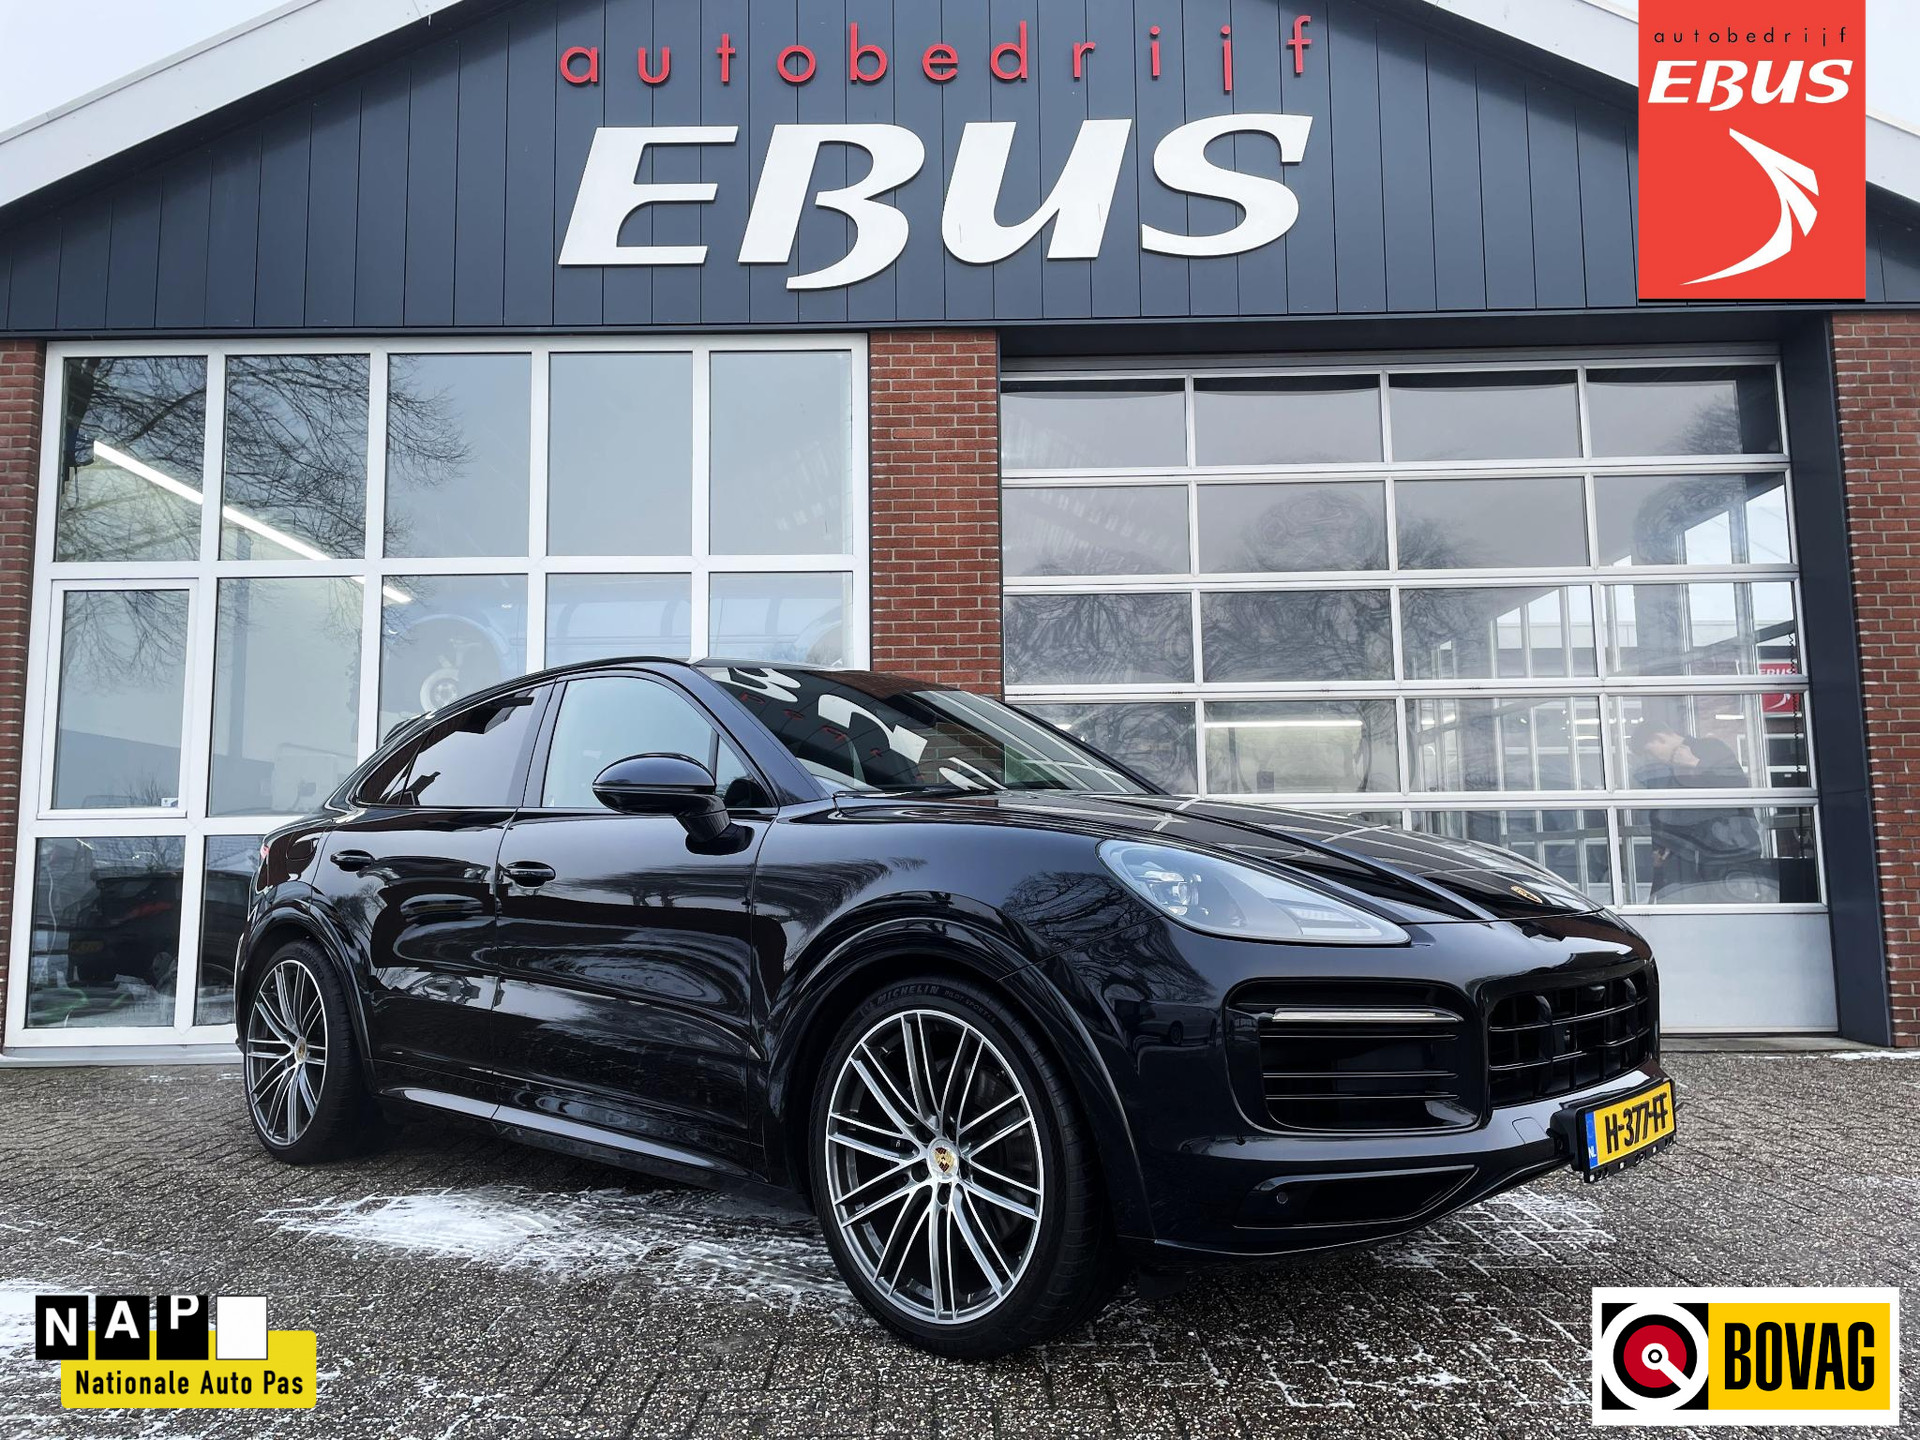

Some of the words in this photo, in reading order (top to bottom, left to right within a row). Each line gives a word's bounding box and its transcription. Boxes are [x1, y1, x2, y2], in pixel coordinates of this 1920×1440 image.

[560, 15, 1313, 93] autobedrijf
[558, 113, 1313, 290] EBUS
[877, 985, 940, 1005] MICHELIN
[1588, 1145, 1597, 1159] NL
[1605, 1092, 1668, 1154] H-377-FF
